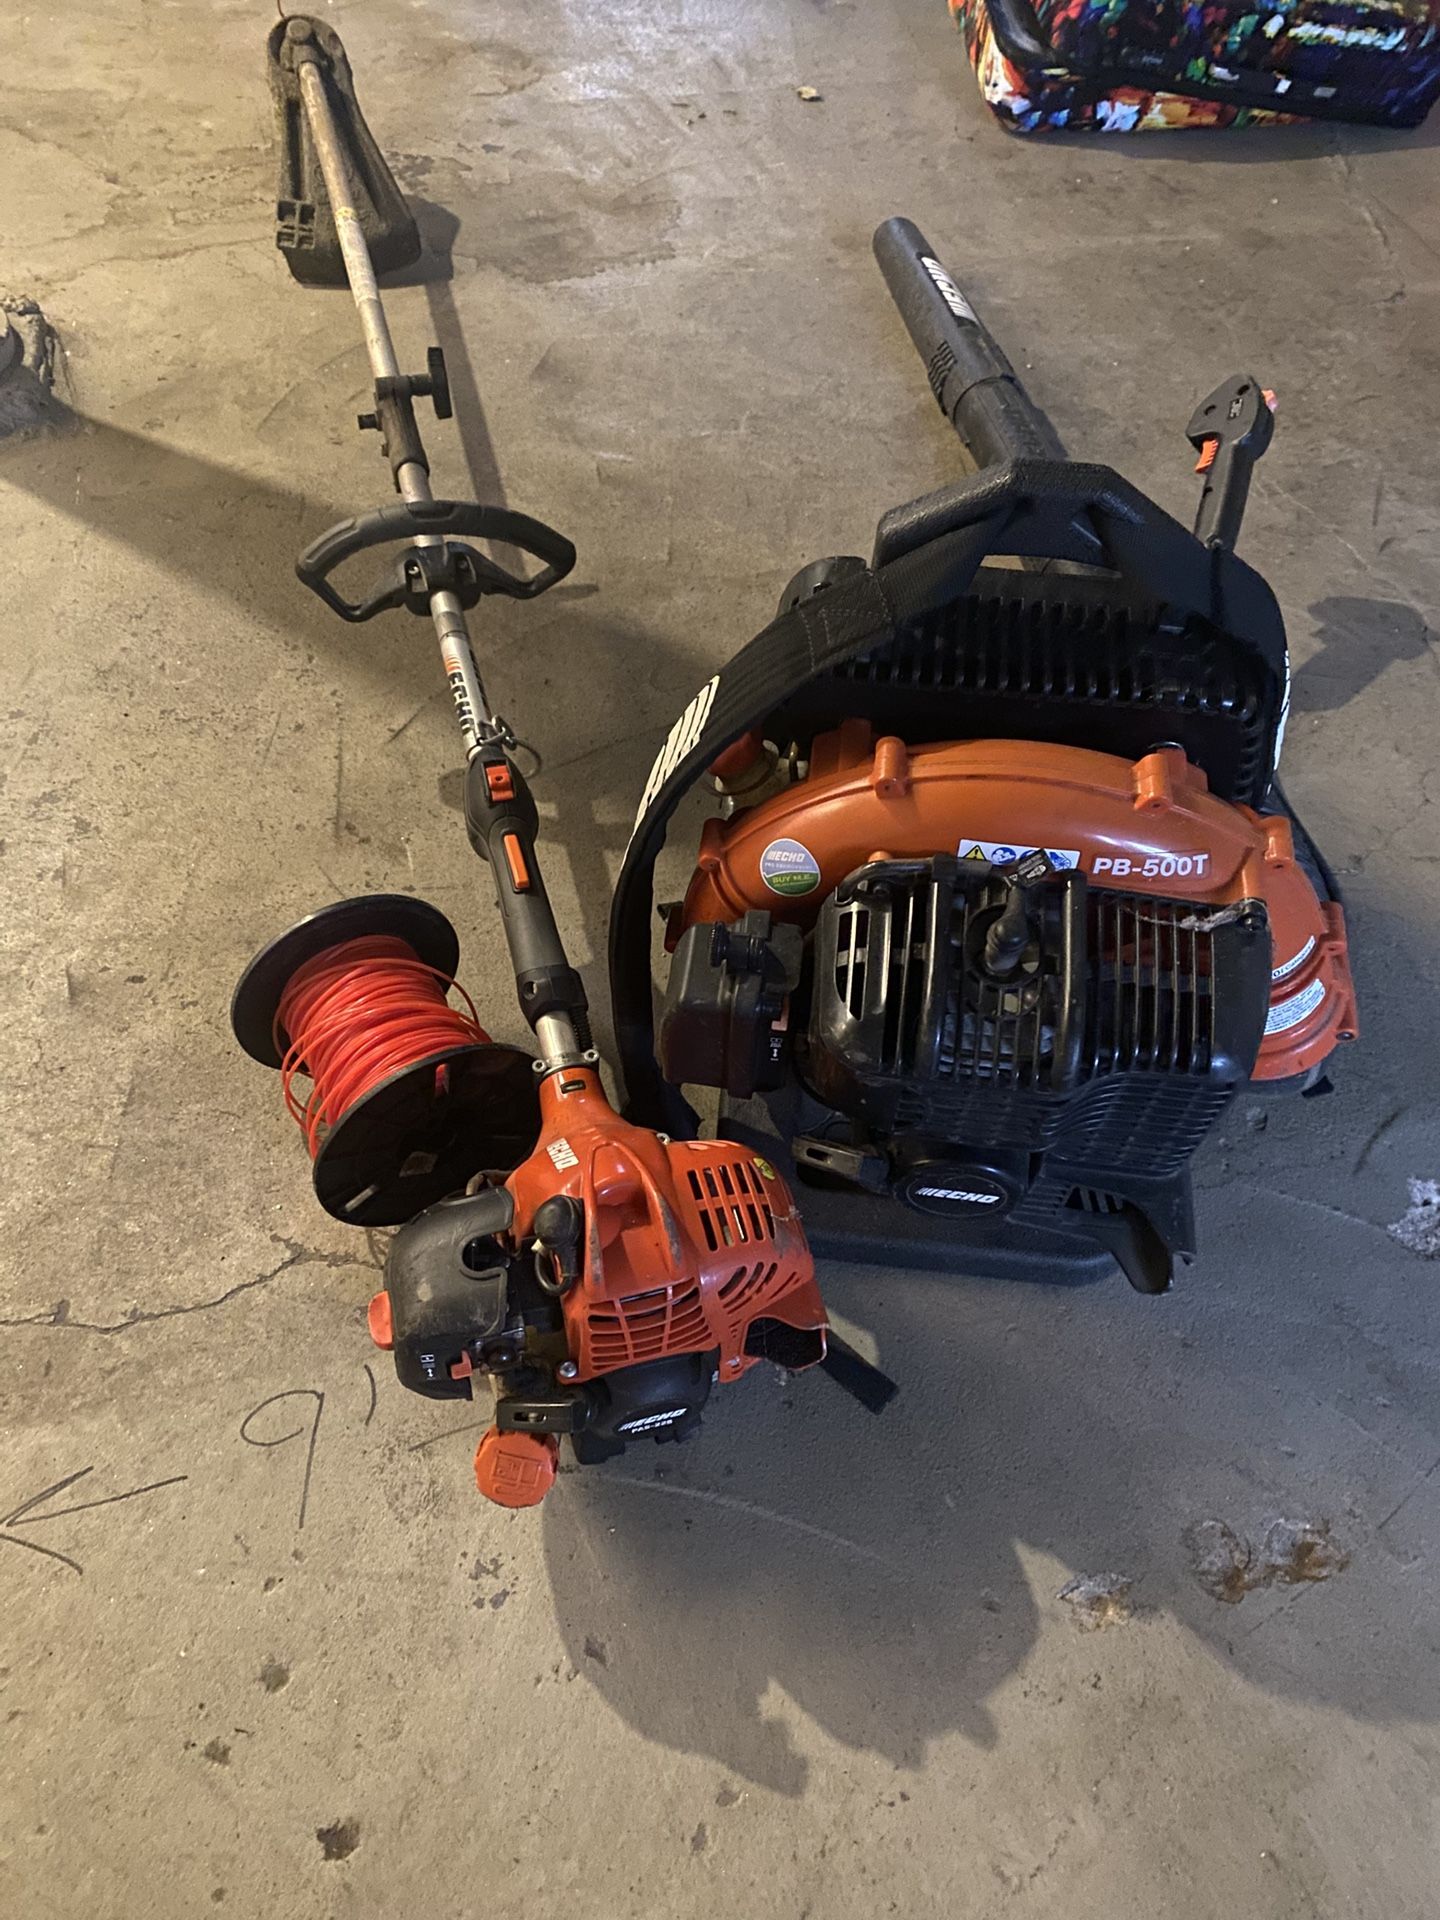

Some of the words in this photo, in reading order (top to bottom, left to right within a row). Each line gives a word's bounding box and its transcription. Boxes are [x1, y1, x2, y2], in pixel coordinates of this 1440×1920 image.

[775, 851, 805, 862] ECHO
[1092, 854, 1209, 877] PB-500T
[546, 1137, 580, 1170] ECHO
[933, 1189, 1000, 1204] ECHO
[633, 1408, 688, 1427] ECHO
